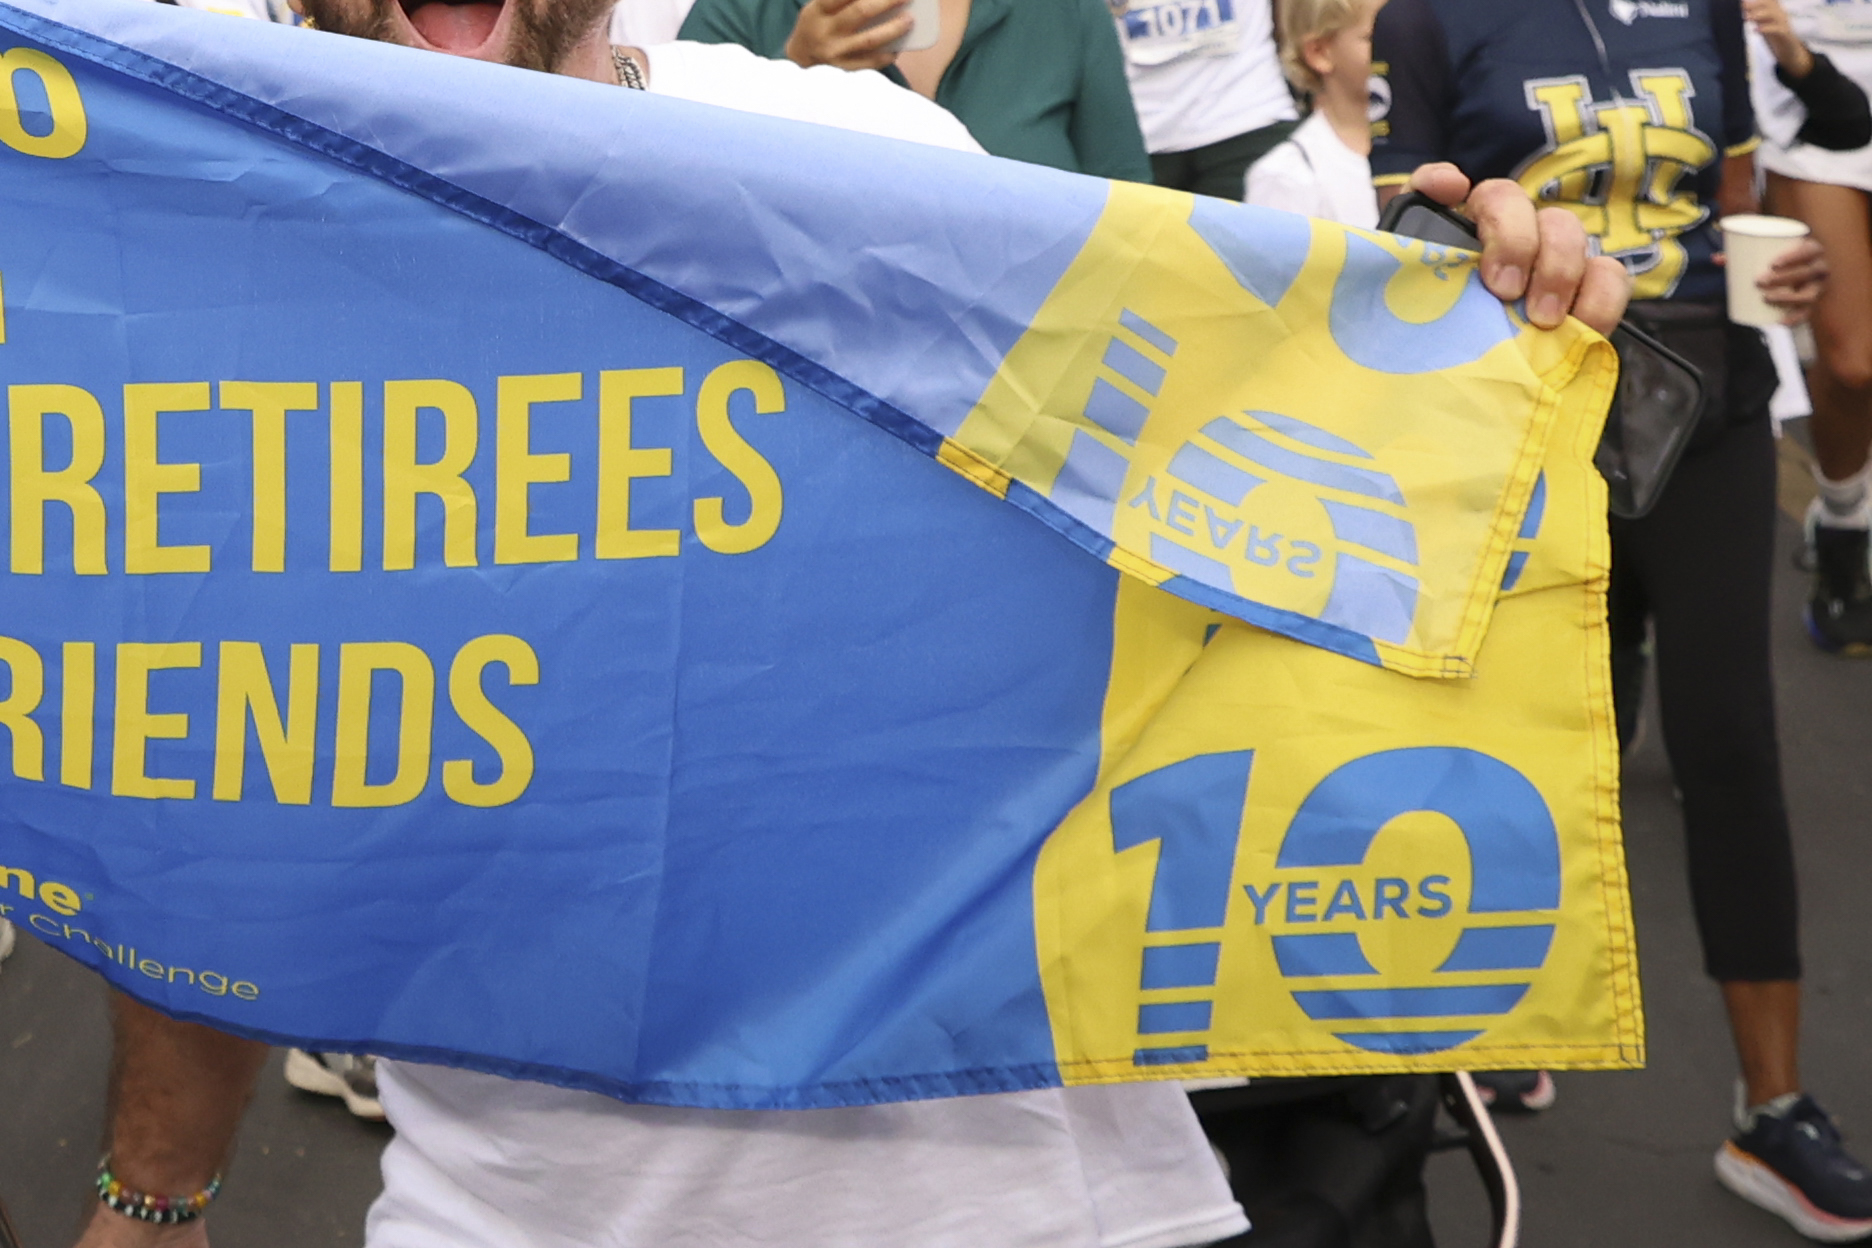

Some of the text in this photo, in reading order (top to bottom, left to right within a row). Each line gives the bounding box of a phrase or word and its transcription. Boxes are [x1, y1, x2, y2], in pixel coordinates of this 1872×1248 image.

[8, 358, 787, 575] RETIREES
[28, 913, 260, 1001] Challenge
[1109, 745, 1563, 1065] 10
[1243, 875, 1453, 925] YEARS
